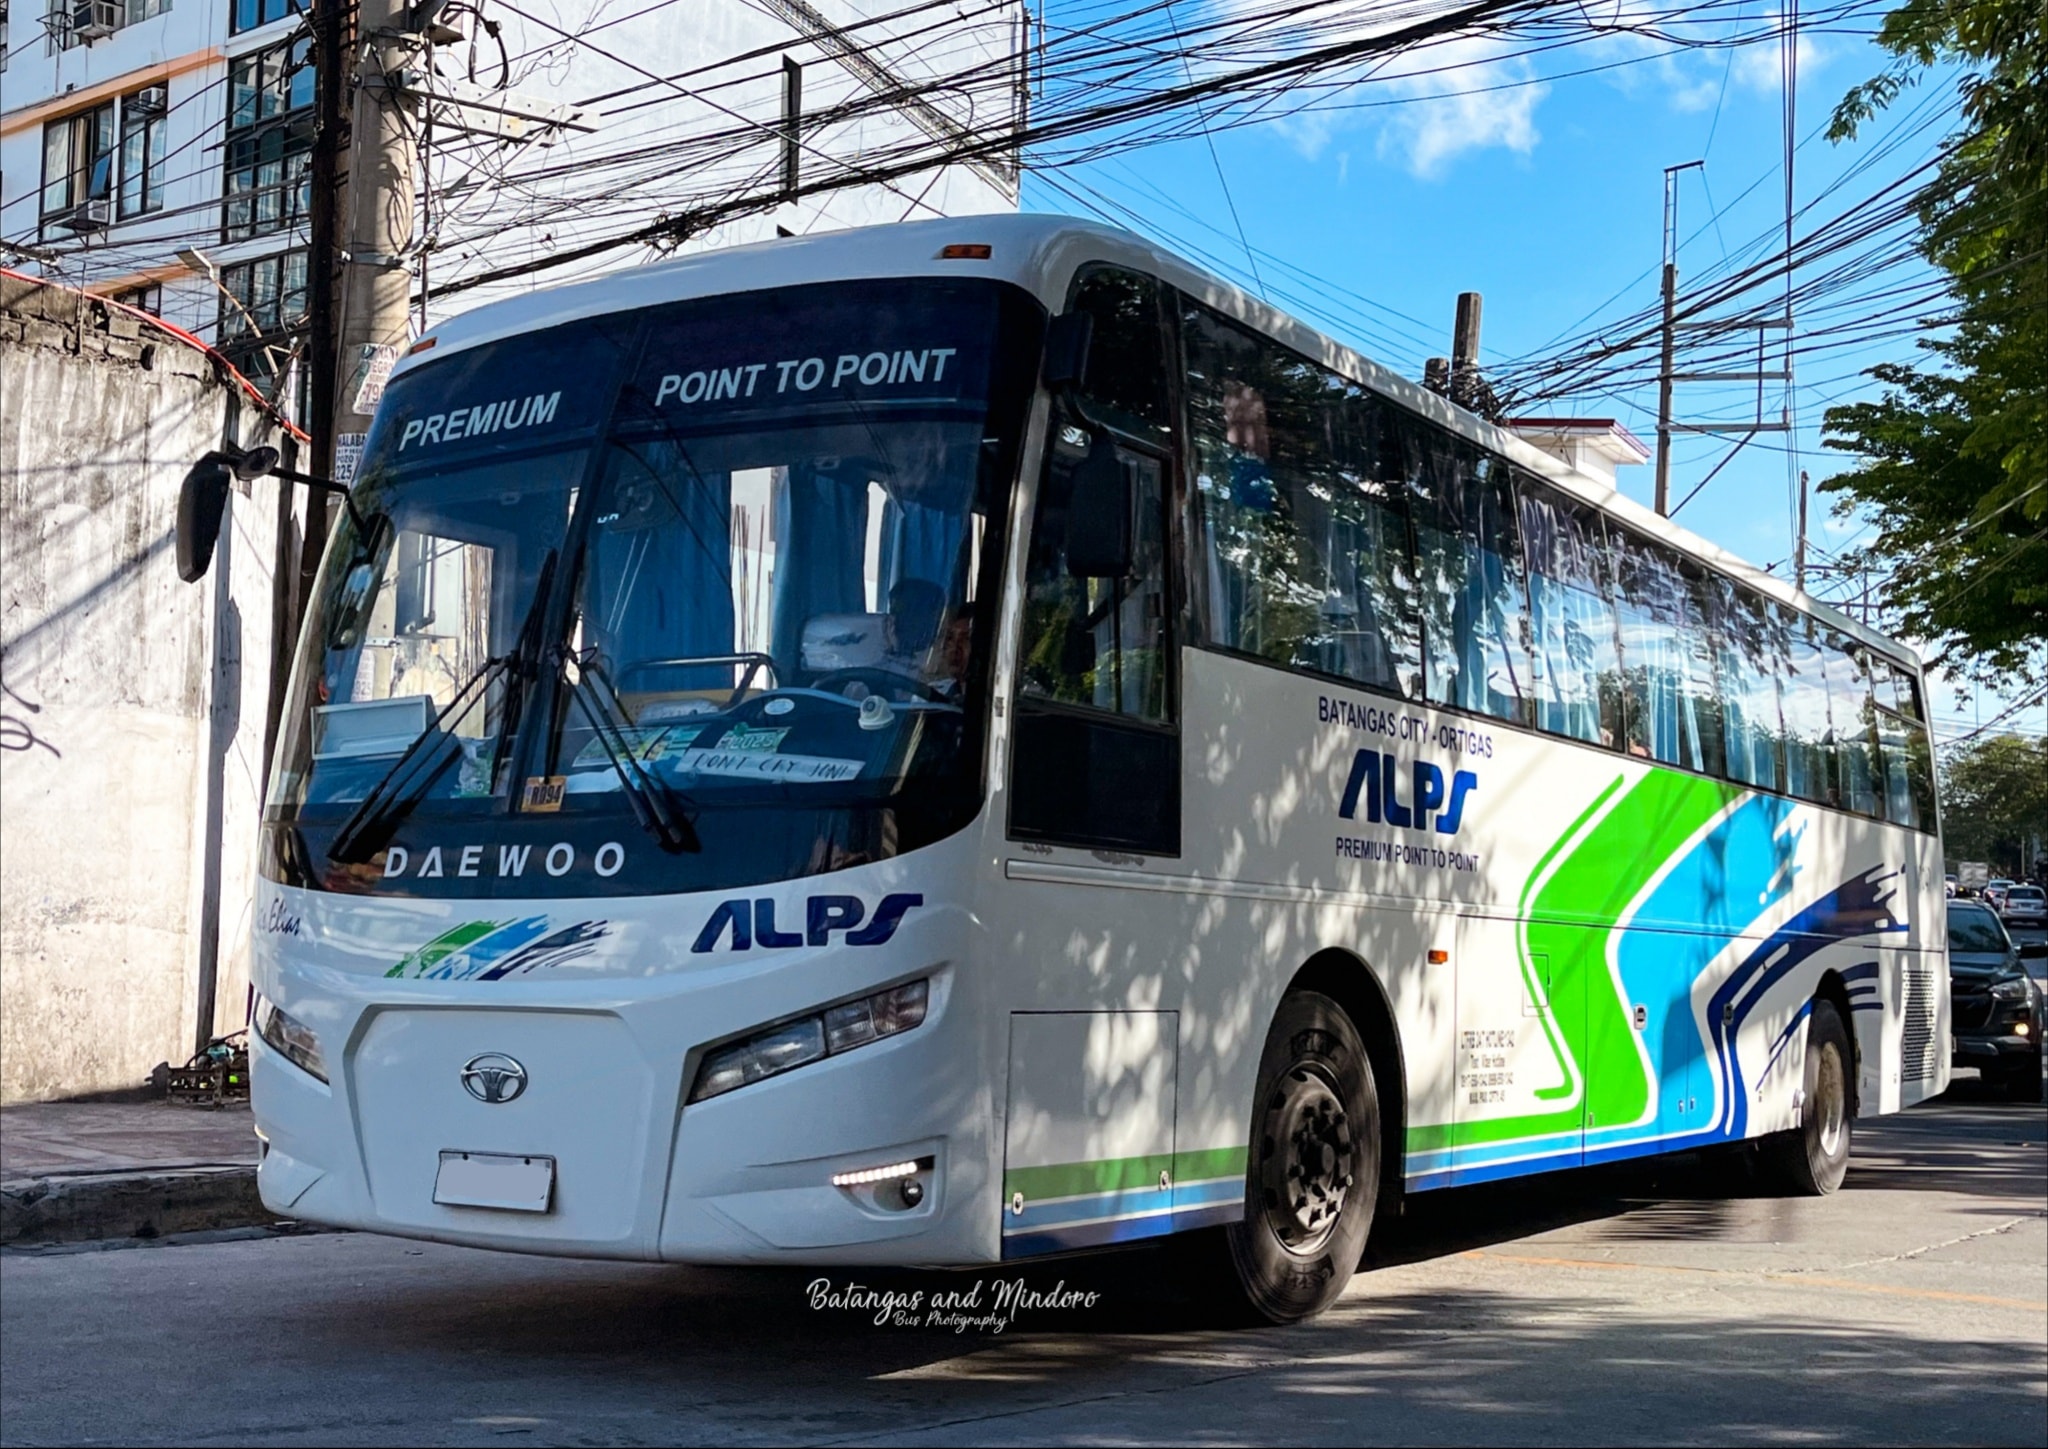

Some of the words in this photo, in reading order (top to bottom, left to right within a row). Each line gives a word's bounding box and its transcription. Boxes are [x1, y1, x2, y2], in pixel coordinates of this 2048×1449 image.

[655, 363, 765, 406] POINT
[777, 358, 824, 394] TO
[832, 348, 956, 388] POINT
[399, 391, 562, 452] PREMIUM
[1319, 696, 1396, 737] BATANGAS
[1400, 716, 1428, 744] CITY
[1439, 725, 1493, 758] ORTIGAS
[1339, 748, 1477, 835] ALPS
[383, 841, 625, 879] DAEWOO
[1336, 837, 1392, 863] PREMIUM
[1395, 846, 1428, 868] POINT
[1432, 849, 1445, 868] TO
[1448, 851, 1479, 873] POINT
[691, 893, 924, 954] ALPS
